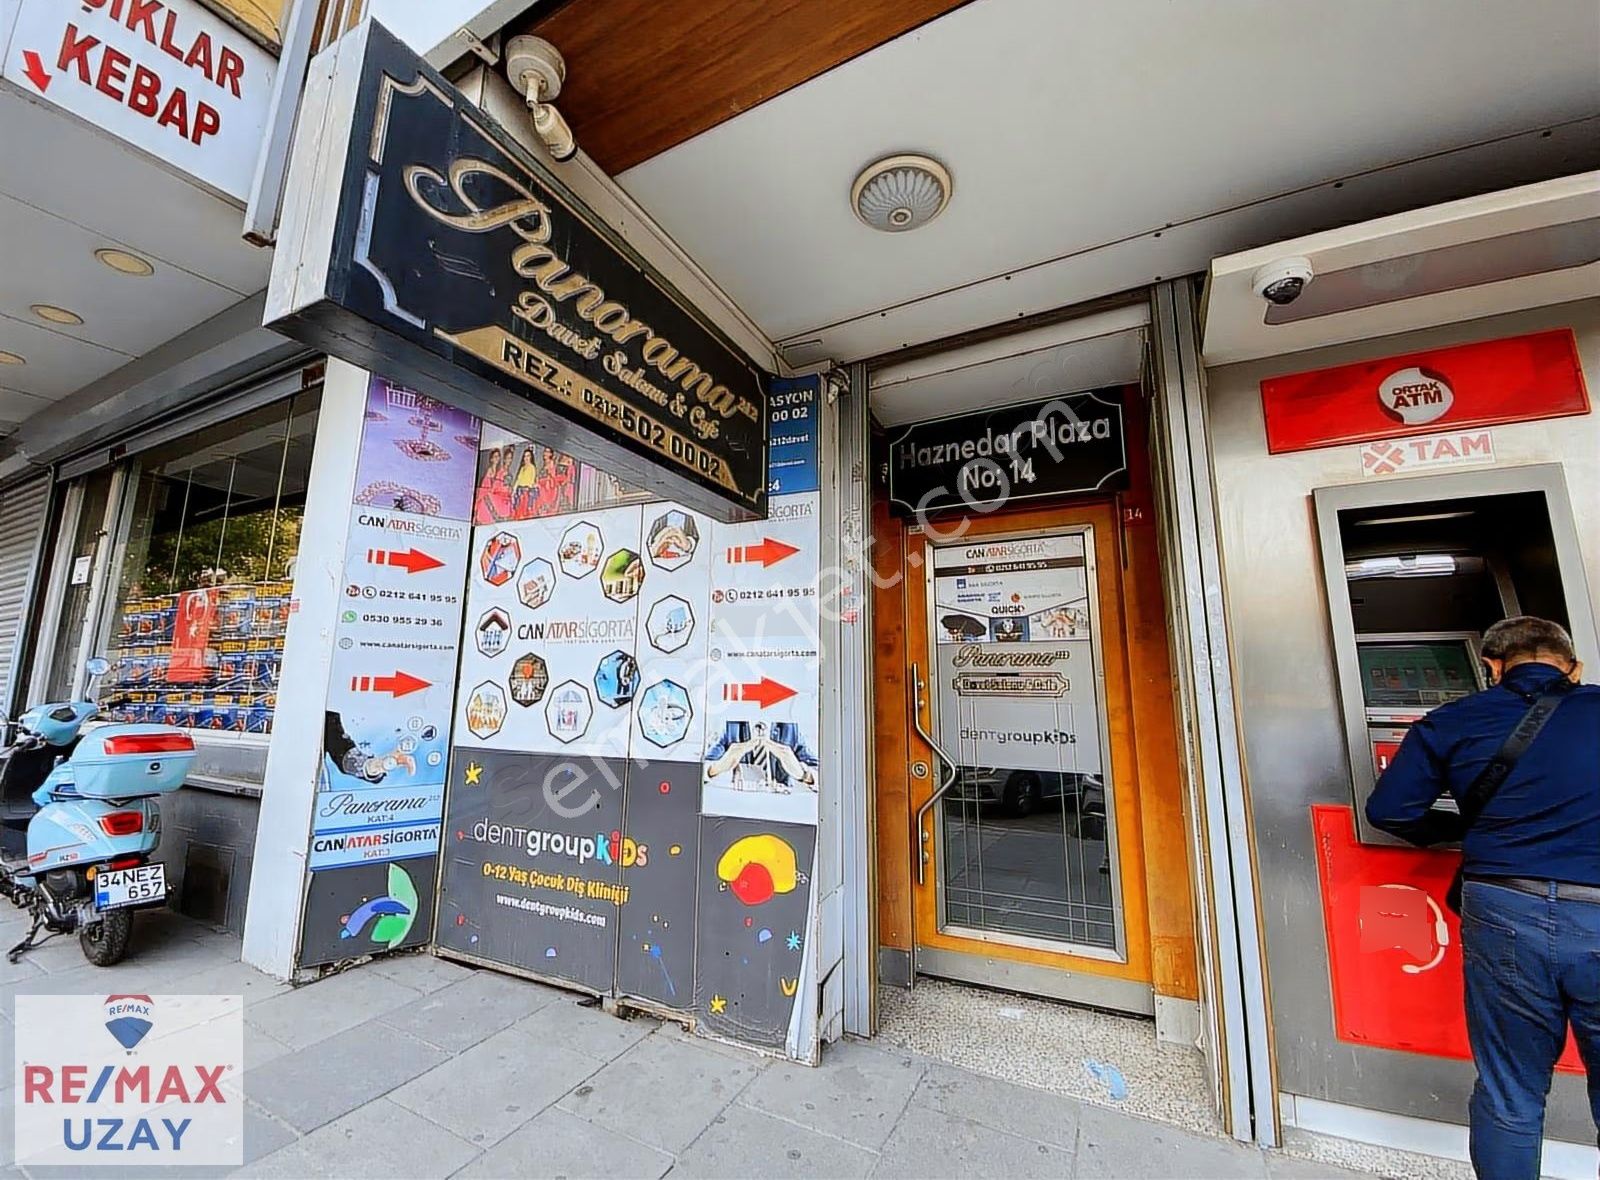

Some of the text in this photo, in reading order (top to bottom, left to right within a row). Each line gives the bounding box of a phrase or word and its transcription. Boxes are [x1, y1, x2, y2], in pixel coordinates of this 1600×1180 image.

[57, 22, 221, 146] KEBAP
[403, 158, 738, 418] Panorama
[512, 291, 601, 360] Davet
[603, 350, 668, 407] Salonu
[669, 392, 687, 418] &
[1392, 382, 1439, 396] ORTAK
[1393, 390, 1443, 409] ATM
[581, 387, 619, 418] 0212
[619, 404, 665, 449] 502
[792, 407, 808, 419] 02
[900, 417, 1111, 470] Haznedar Plaza
[1409, 434, 1491, 461] TAM
[1010, 457, 1035, 485] 14
[1127, 508, 1143, 521] 14
[379, 590, 406, 599] 0212
[408, 592, 426, 601] 641
[740, 591, 764, 599] 0212
[766, 590, 783, 598] 641
[362, 614, 390, 623] 0530
[991, 605, 1020, 614] QUICK
[953, 644, 1055, 667] Panorama
[320, 793, 428, 817] Panorama
[128, 881, 162, 899] 657
[483, 862, 629, 905] 0-12 Yaş Çocuk Diş Kliniği
[496, 893, 606, 927] www.dentgroupkids.com
